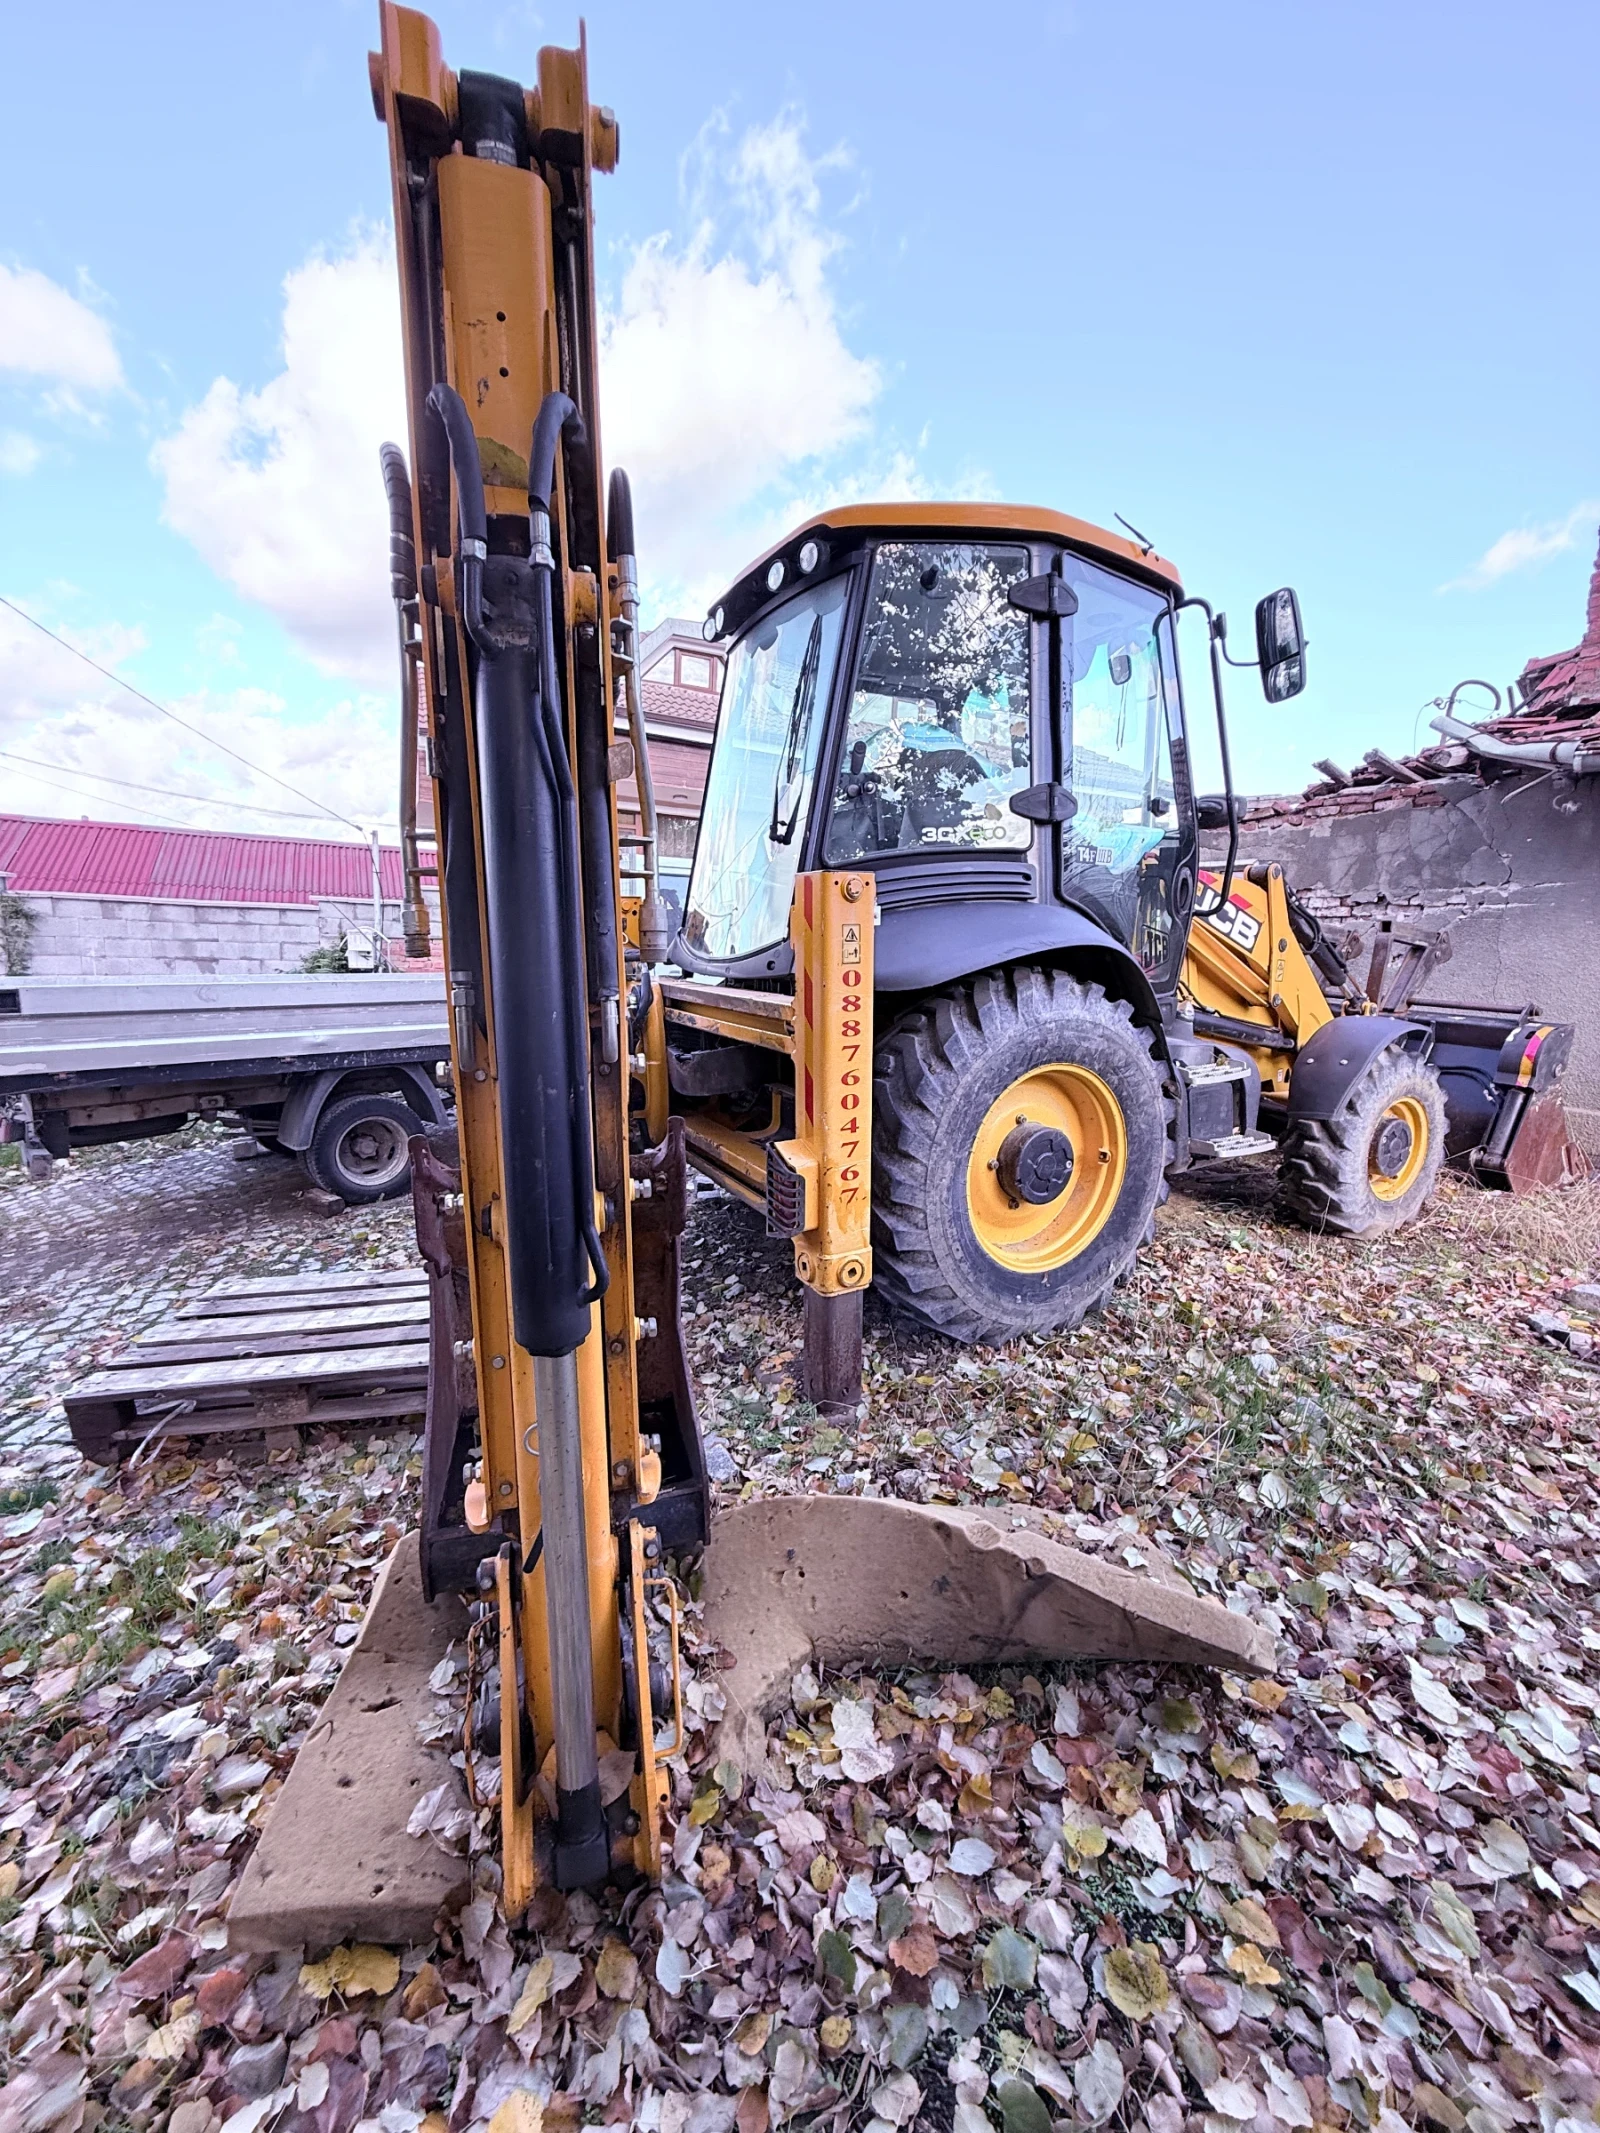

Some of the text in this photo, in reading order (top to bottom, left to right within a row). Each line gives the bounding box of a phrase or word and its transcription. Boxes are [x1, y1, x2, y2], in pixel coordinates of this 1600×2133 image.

[1142, 929, 1169, 968] JCB
[1194, 888, 1260, 949] JCB
[840, 969, 862, 1204] 0887604767
